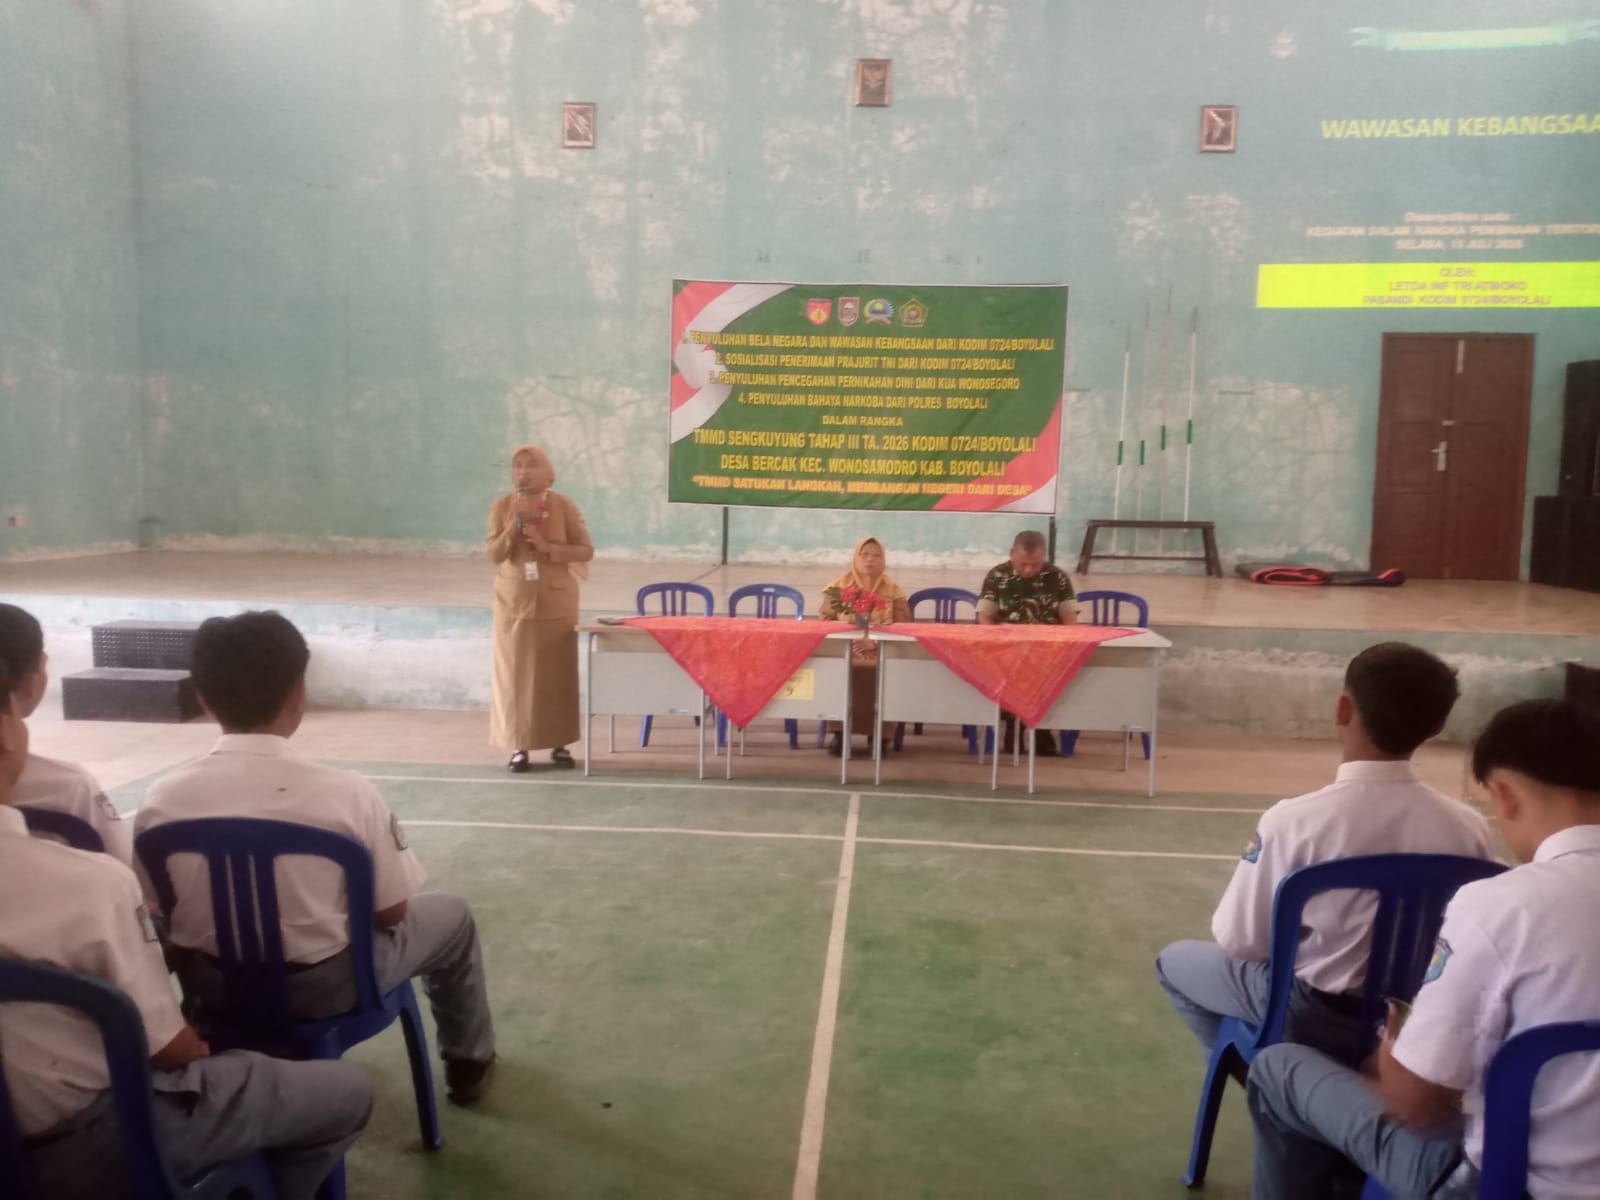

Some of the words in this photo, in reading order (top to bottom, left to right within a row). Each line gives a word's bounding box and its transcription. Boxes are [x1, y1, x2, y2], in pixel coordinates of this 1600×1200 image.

[1321, 118, 1450, 139] WAWASAN
[690, 331, 746, 346] PENYULUHAN
[750, 334, 770, 347] BELA
[773, 334, 808, 348] NEGARA
[810, 335, 828, 348] DAN
[830, 336, 873, 349] WAWASAN
[875, 336, 933, 350] KEBANGSAAN
[936, 337, 957, 350] DARI
[959, 337, 987, 351] KODIM
[715, 353, 724, 366] 2.
[725, 353, 778, 367] SOSIALISASI
[780, 355, 835, 368] PENERIMAAN
[838, 356, 879, 369] PRAJURIT
[881, 357, 896, 369] TNI
[898, 357, 918, 370] DARI
[920, 358, 949, 370] KODIM
[720, 372, 777, 386] PENYULUHAN
[778, 373, 836, 387] PENCEGAHAN
[838, 375, 893, 389] PERNIKAHAN
[896, 376, 913, 389] DINI
[916, 377, 936, 389] DARI
[938, 377, 956, 389] KUA
[958, 377, 1020, 390] WONOSEGORO
[737, 392, 746, 405] 4.
[748, 392, 806, 406] PENYULUHAN
[808, 394, 841, 407] BAHAYA
[843, 395, 884, 408] NARKOBA
[885, 396, 906, 408] DARI
[908, 397, 942, 409] POLRES
[946, 397, 988, 410] BOYOLALI
[822, 415, 857, 426] DALAM
[860, 416, 903, 427] RANGKA
[693, 428, 726, 445] TMMD
[728, 430, 806, 448] SENGKUYUNG
[809, 433, 845, 449] TAHAP
[848, 434, 859, 450] III
[863, 435, 879, 450] TA.
[912, 435, 948, 451] KODIM
[720, 454, 749, 470] DESA
[752, 456, 797, 472] BERCAK
[800, 458, 825, 473] KEC.
[828, 458, 917, 475] WONOSAMODRO
[920, 460, 946, 476] KAB.
[950, 460, 1006, 477] BOYOLALI
[733, 477, 785, 490] SATUKAN
[787, 479, 845, 495] LANGKAH,
[847, 481, 920, 495] MEMBANGUN
[922, 483, 964, 495] NEGERI
[967, 483, 994, 496] DARI
